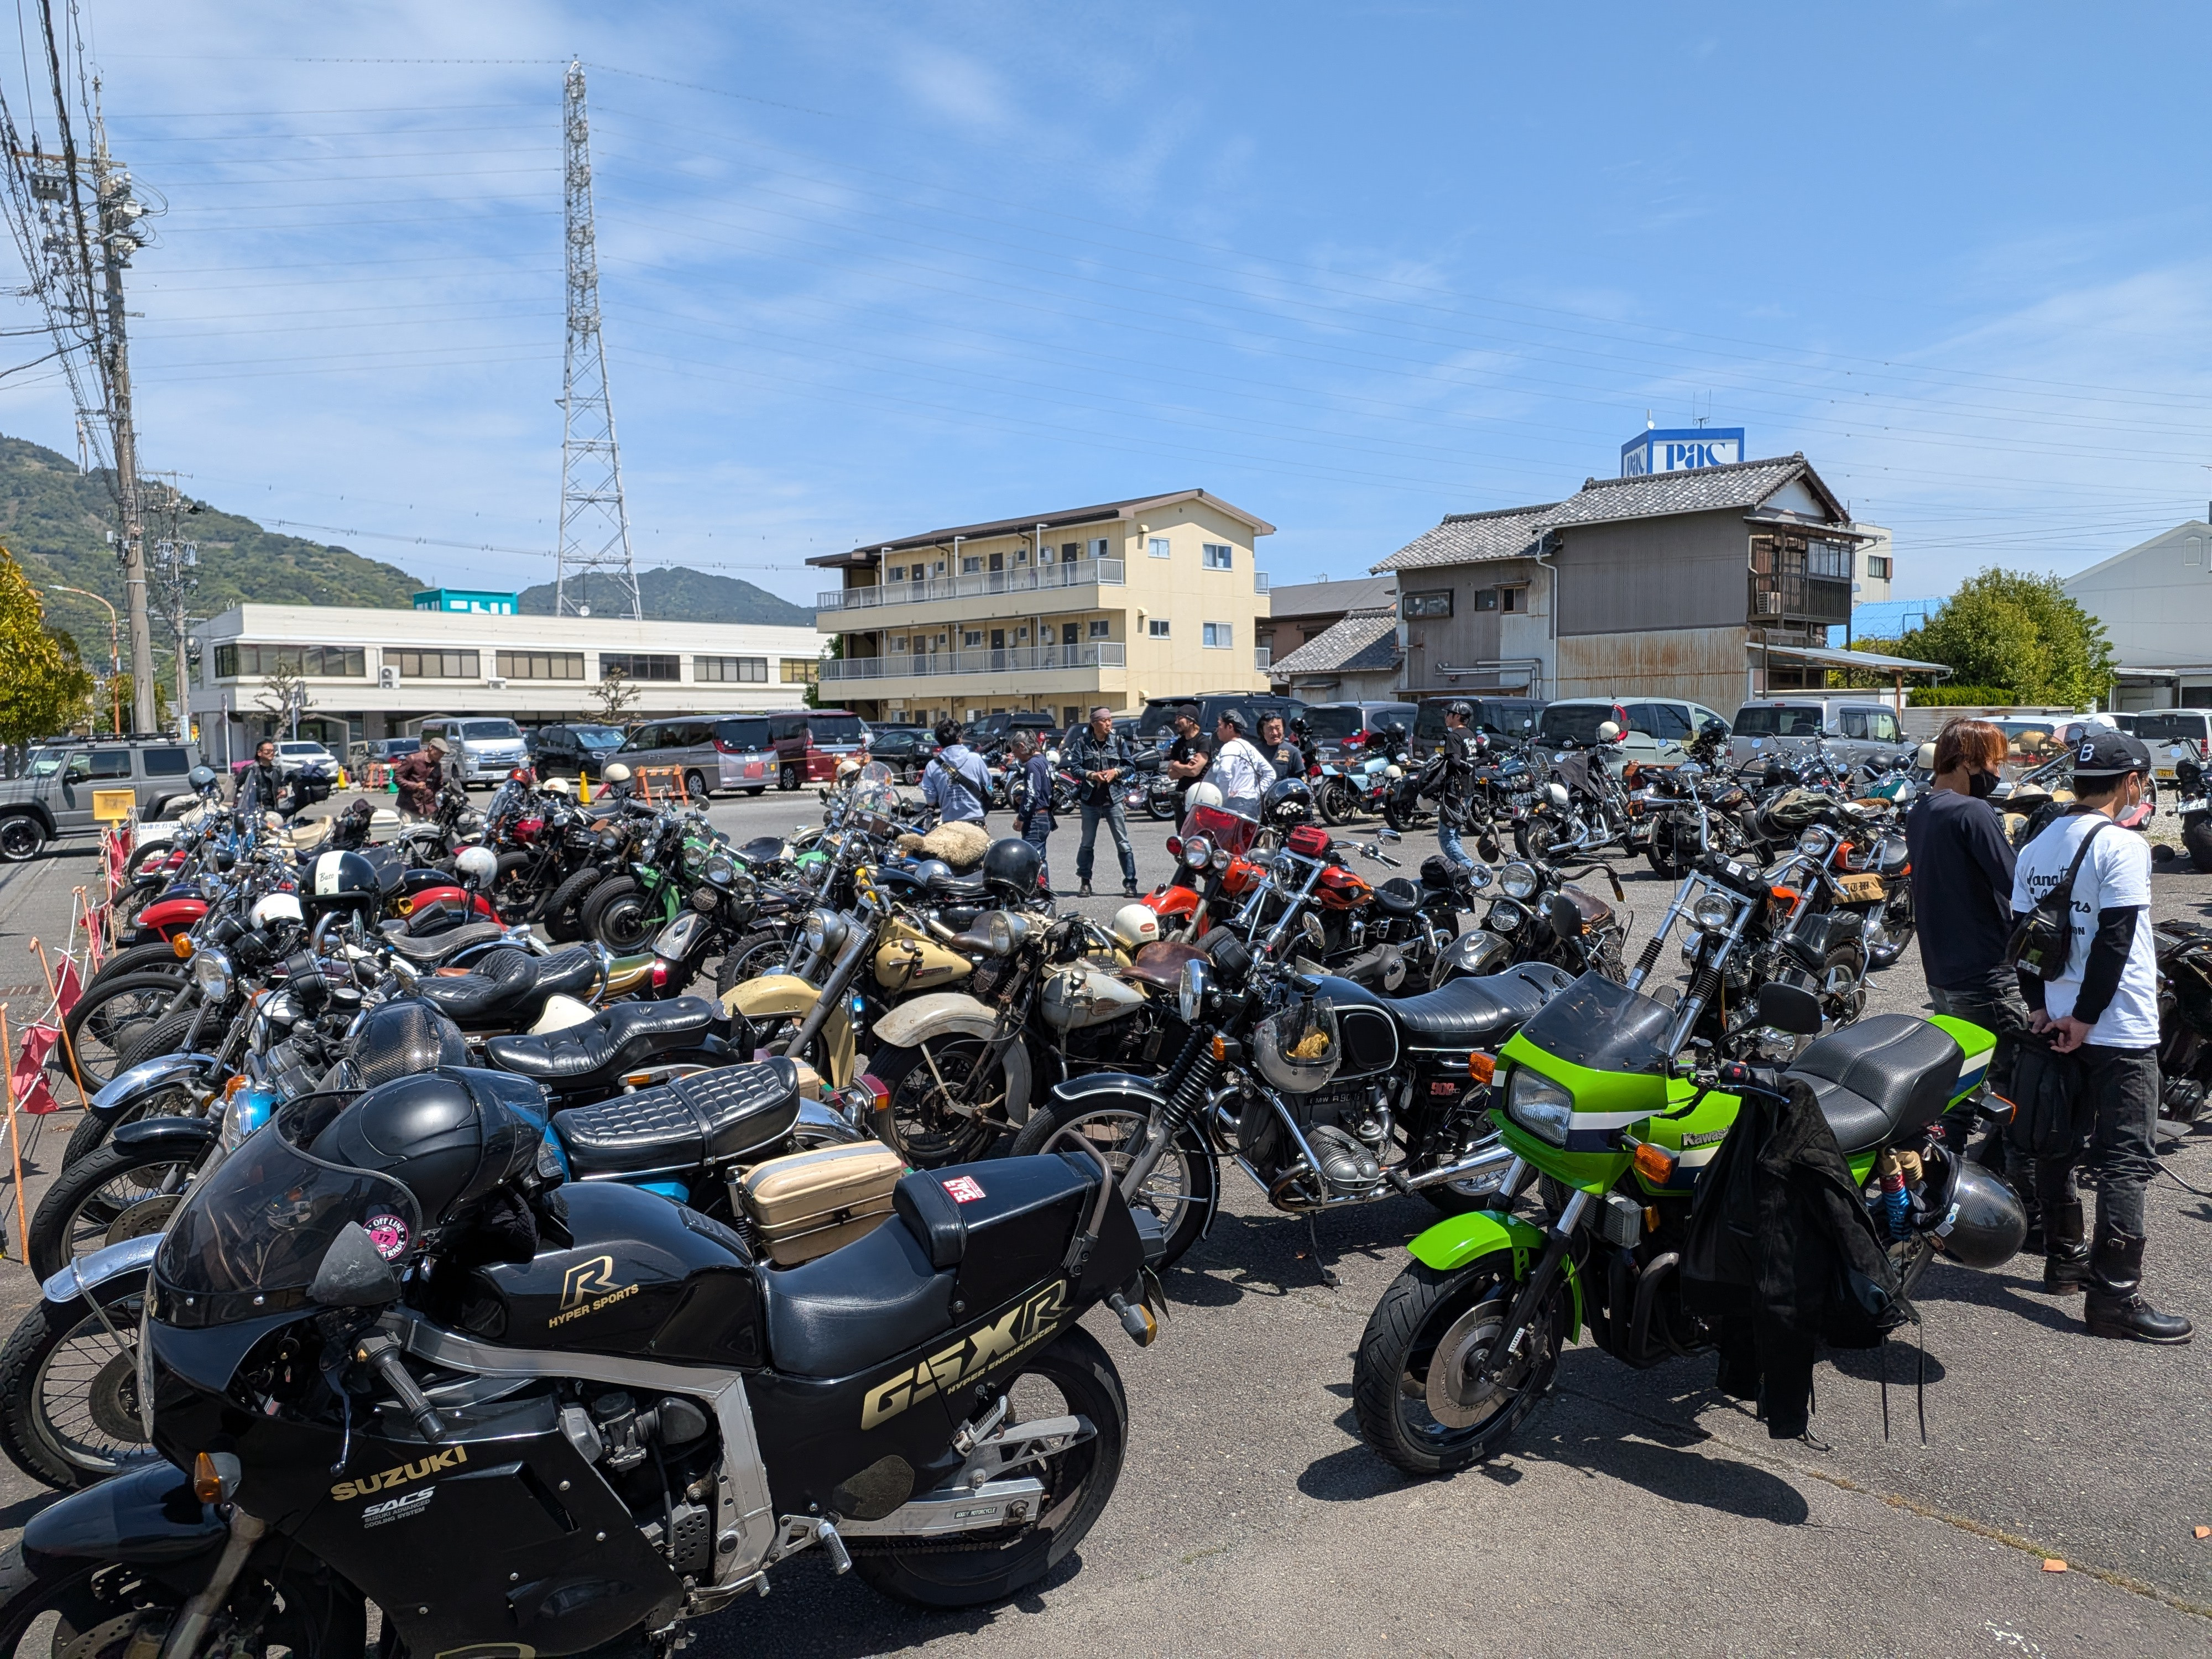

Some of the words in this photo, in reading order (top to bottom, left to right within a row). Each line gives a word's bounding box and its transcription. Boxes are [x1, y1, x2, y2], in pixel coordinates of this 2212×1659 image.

[2080, 744, 2095, 761] B
[2179, 803, 2205, 811] 56-45
[373, 1218, 388, 1226] OFF
[389, 1219, 405, 1234] LINE
[378, 1234, 390, 1242] 17
[382, 1239, 405, 1258] TRADE
[560, 1256, 623, 1311] R
[549, 1305, 589, 1328] HYPER
[593, 1284, 639, 1310] SPORTS
[947, 1369, 985, 1395] HYPER
[331, 1445, 467, 1501] SUZUKI
[361, 1485, 436, 1519] SACS
[364, 1508, 391, 1523] SUZUKI
[393, 1499, 430, 1515] ADVANCED
[971, 1507, 996, 1516] MOTORCYCLE
[364, 1516, 395, 1528] COOLING
[398, 1506, 425, 1519] SYSTEM
